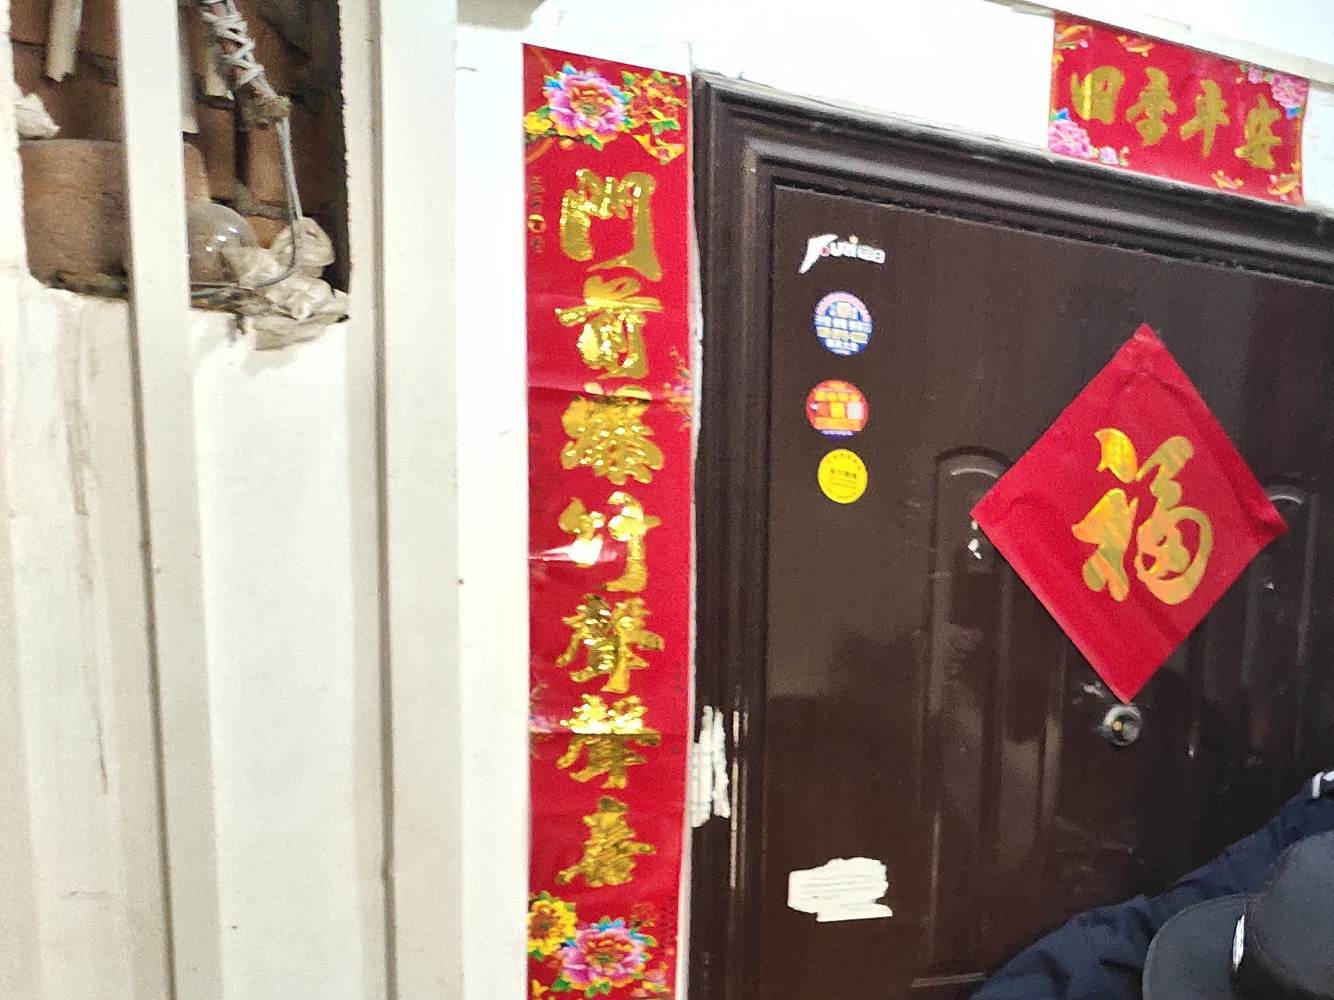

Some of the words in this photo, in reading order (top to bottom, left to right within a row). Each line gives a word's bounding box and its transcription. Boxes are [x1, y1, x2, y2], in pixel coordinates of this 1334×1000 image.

[1070, 66, 1281, 170] 四季平安
[1071, 427, 1214, 606] 福
